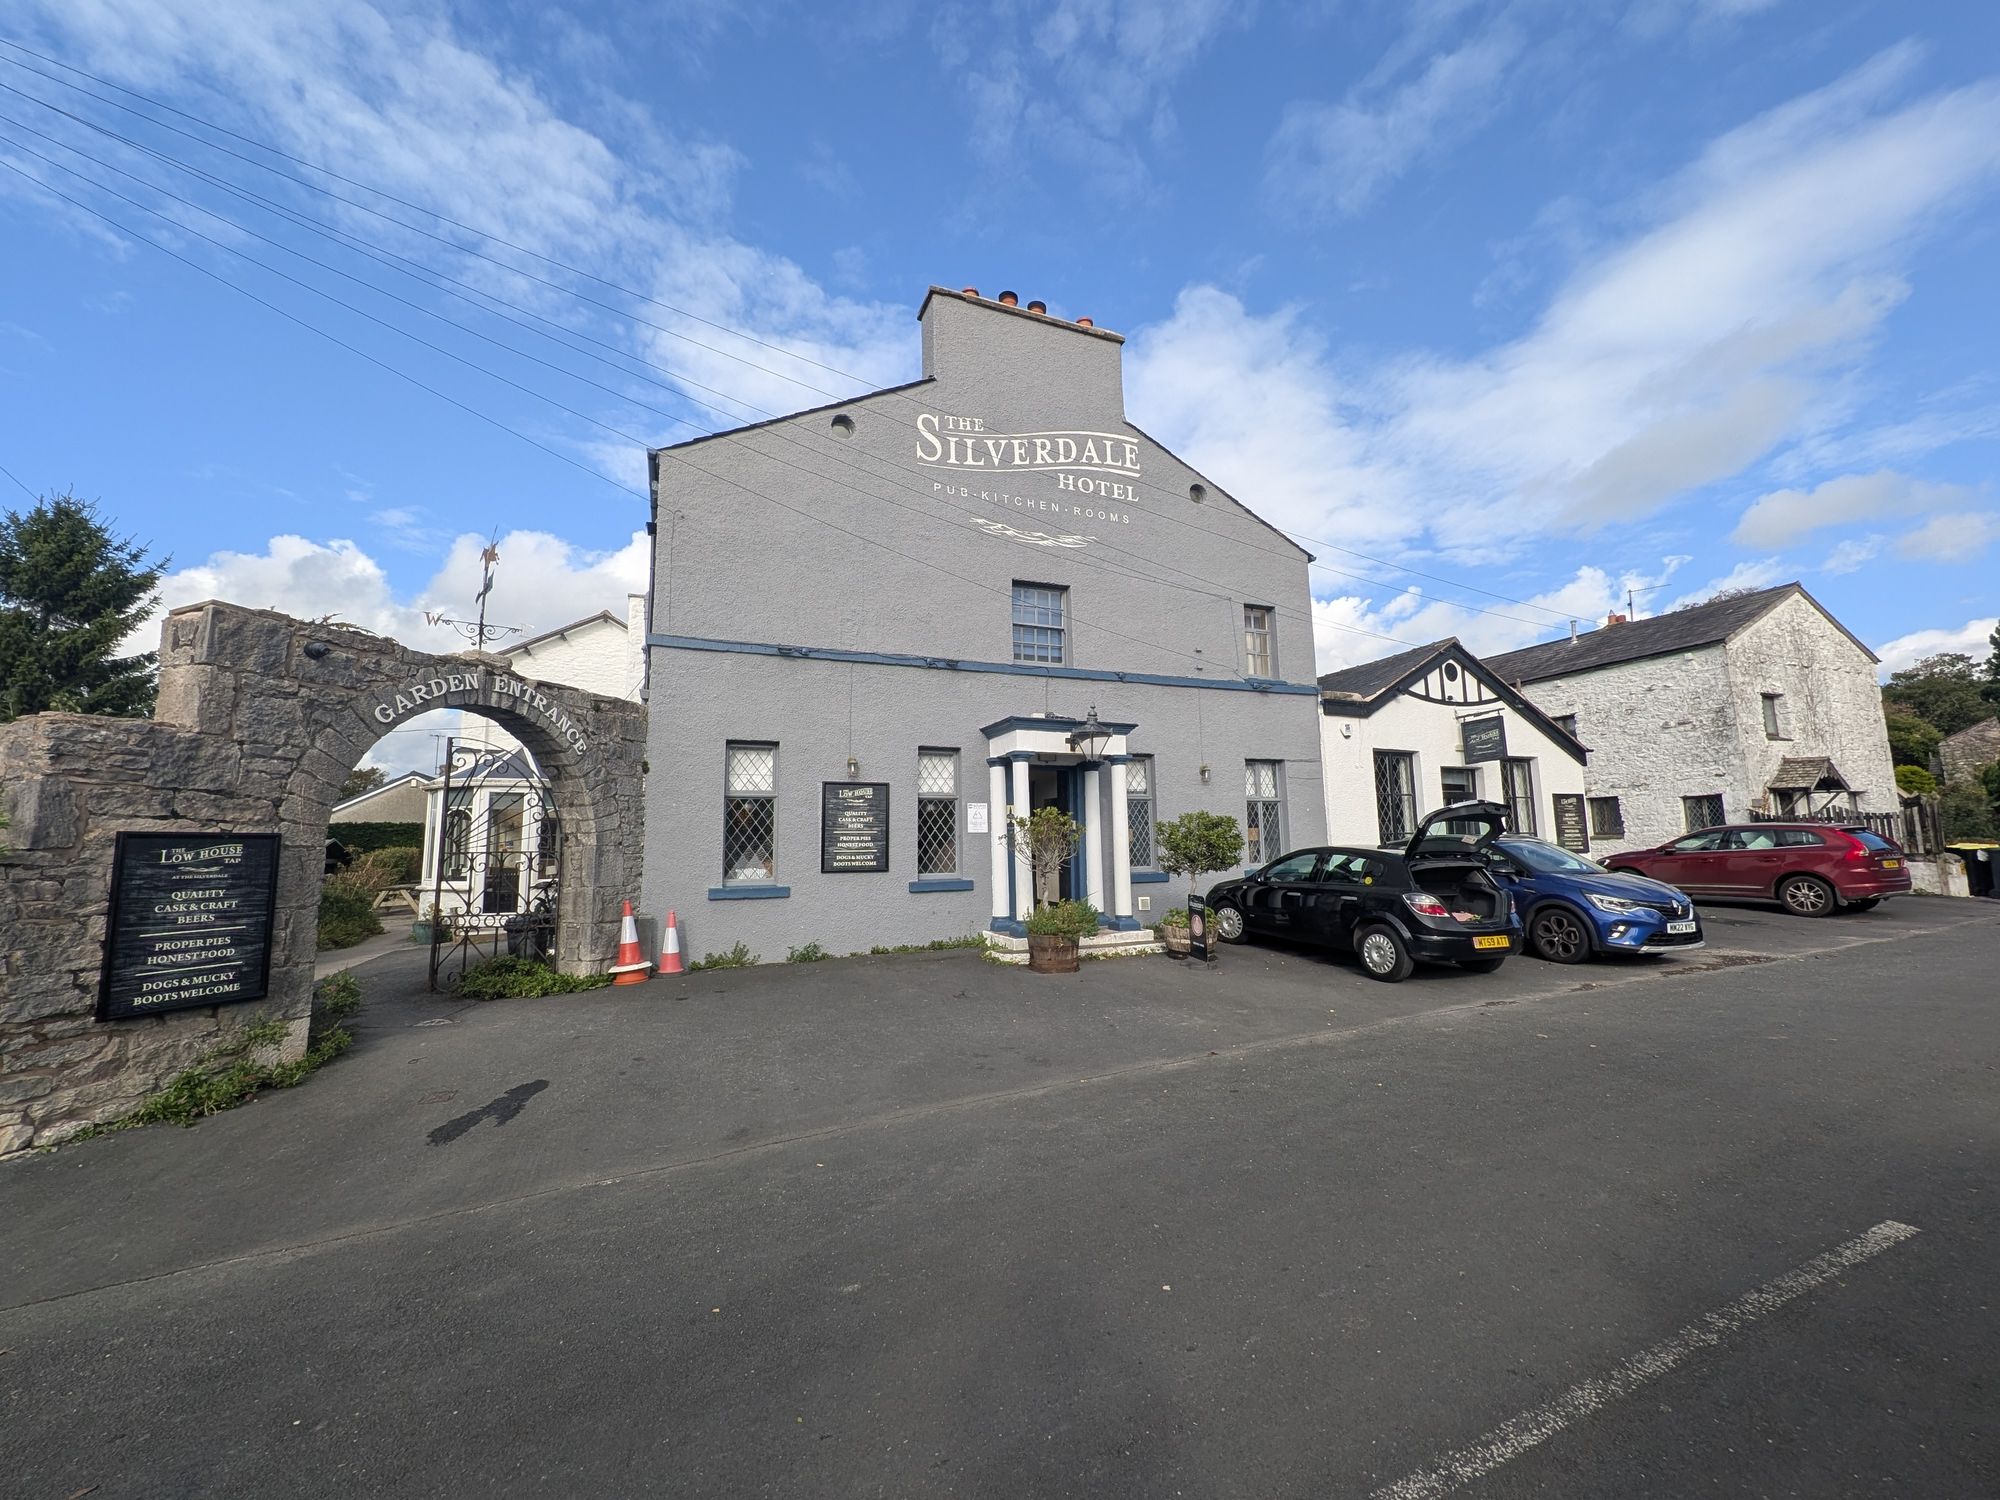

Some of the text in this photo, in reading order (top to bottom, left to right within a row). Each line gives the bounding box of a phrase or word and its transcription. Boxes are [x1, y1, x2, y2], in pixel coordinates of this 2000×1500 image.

[944, 415, 984, 432] THE
[916, 413, 1141, 470] SILVERDALE
[1057, 473, 1140, 502] HOTEL
[424, 611, 444, 627] W
[374, 673, 588, 756] GARDEN ENTRANCE
[160, 846, 243, 863] LOW HOUSE
[171, 889, 226, 901] QUALITY
[154, 900, 239, 914] CASK & CRAFT
[176, 914, 215, 925] BEERS
[154, 936, 231, 951] PROPER PIES
[146, 948, 236, 965] HONEST FOOD
[141, 971, 236, 992] DOGS & MUCKY
[132, 982, 241, 1006] BOOTS WELCOME
